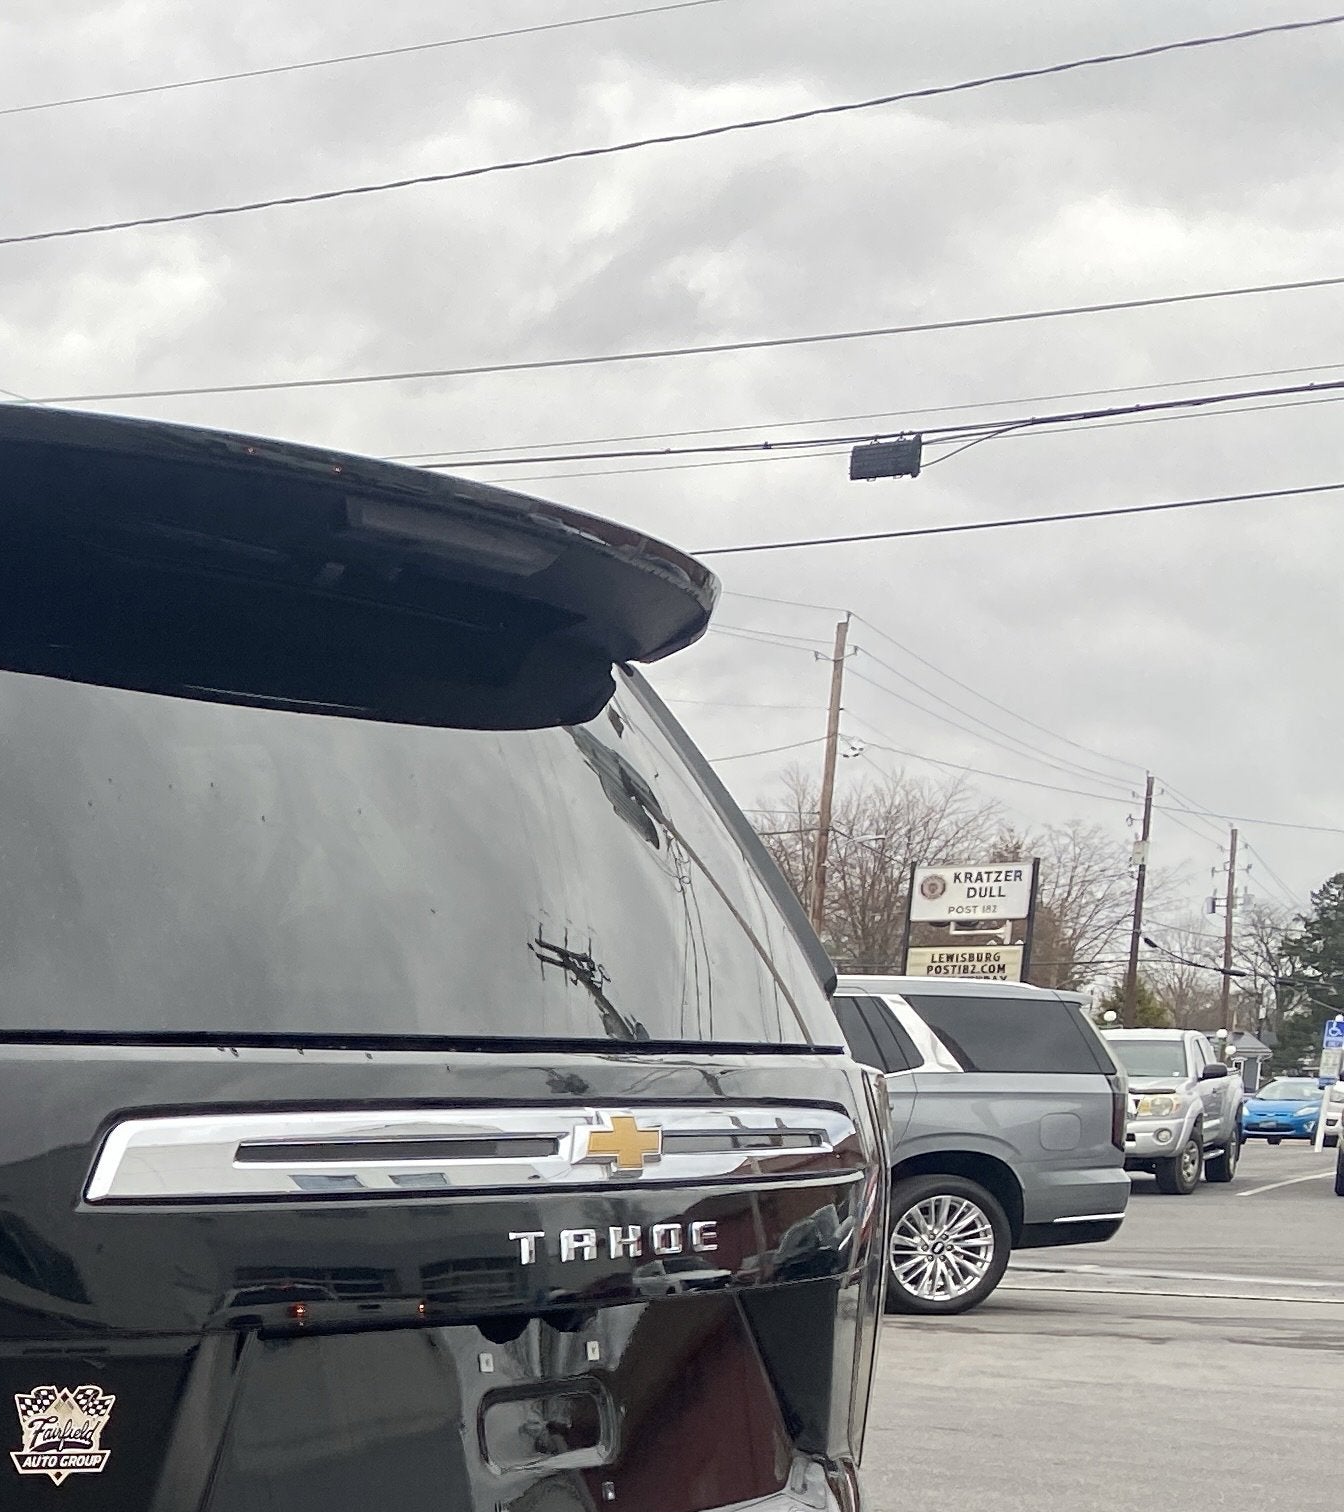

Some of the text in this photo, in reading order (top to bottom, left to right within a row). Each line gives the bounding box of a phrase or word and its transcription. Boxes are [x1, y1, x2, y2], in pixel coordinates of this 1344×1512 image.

[953, 869, 1023, 884] KRATZER
[967, 886, 1006, 899] DULL
[948, 904, 997, 914] POST 182
[931, 952, 1001, 964] LEWISBURG
[508, 1220, 718, 1265] TAHOE
[28, 1416, 101, 1450] Fairfield
[22, 1455, 102, 1468] AUTO GROUP
